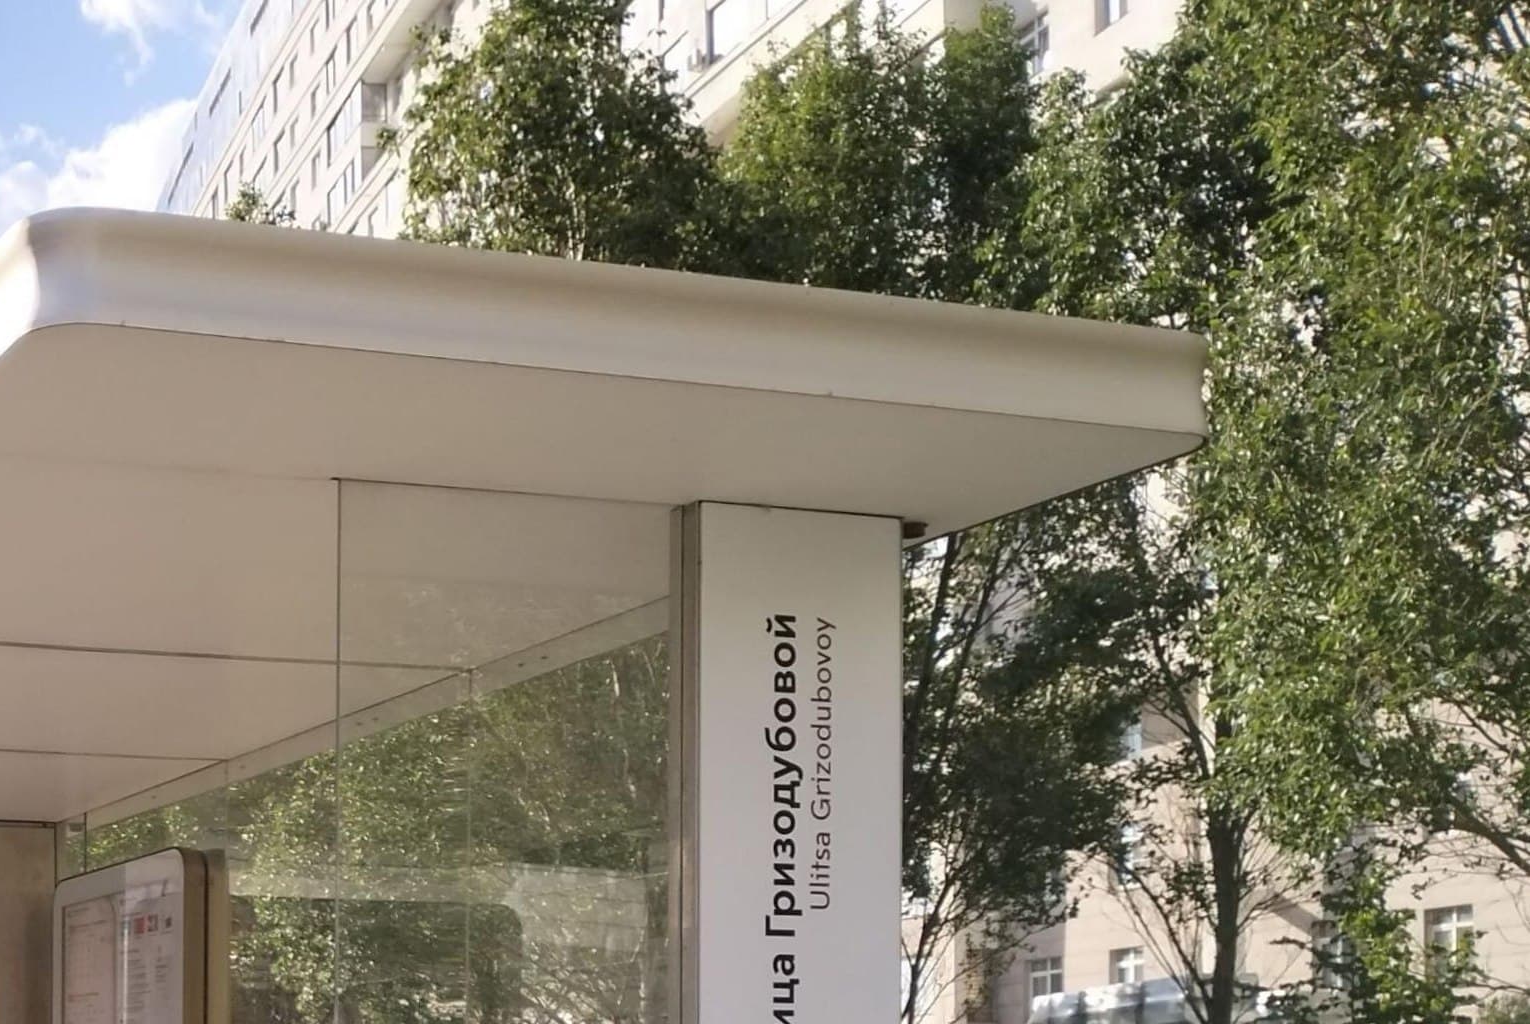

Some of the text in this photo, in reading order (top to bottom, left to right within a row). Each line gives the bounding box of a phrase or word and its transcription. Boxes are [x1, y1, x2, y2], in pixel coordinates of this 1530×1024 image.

[765, 614, 804, 937] Гризодубовой
[809, 617, 836, 910] Ulitsa Grizodubovoy
